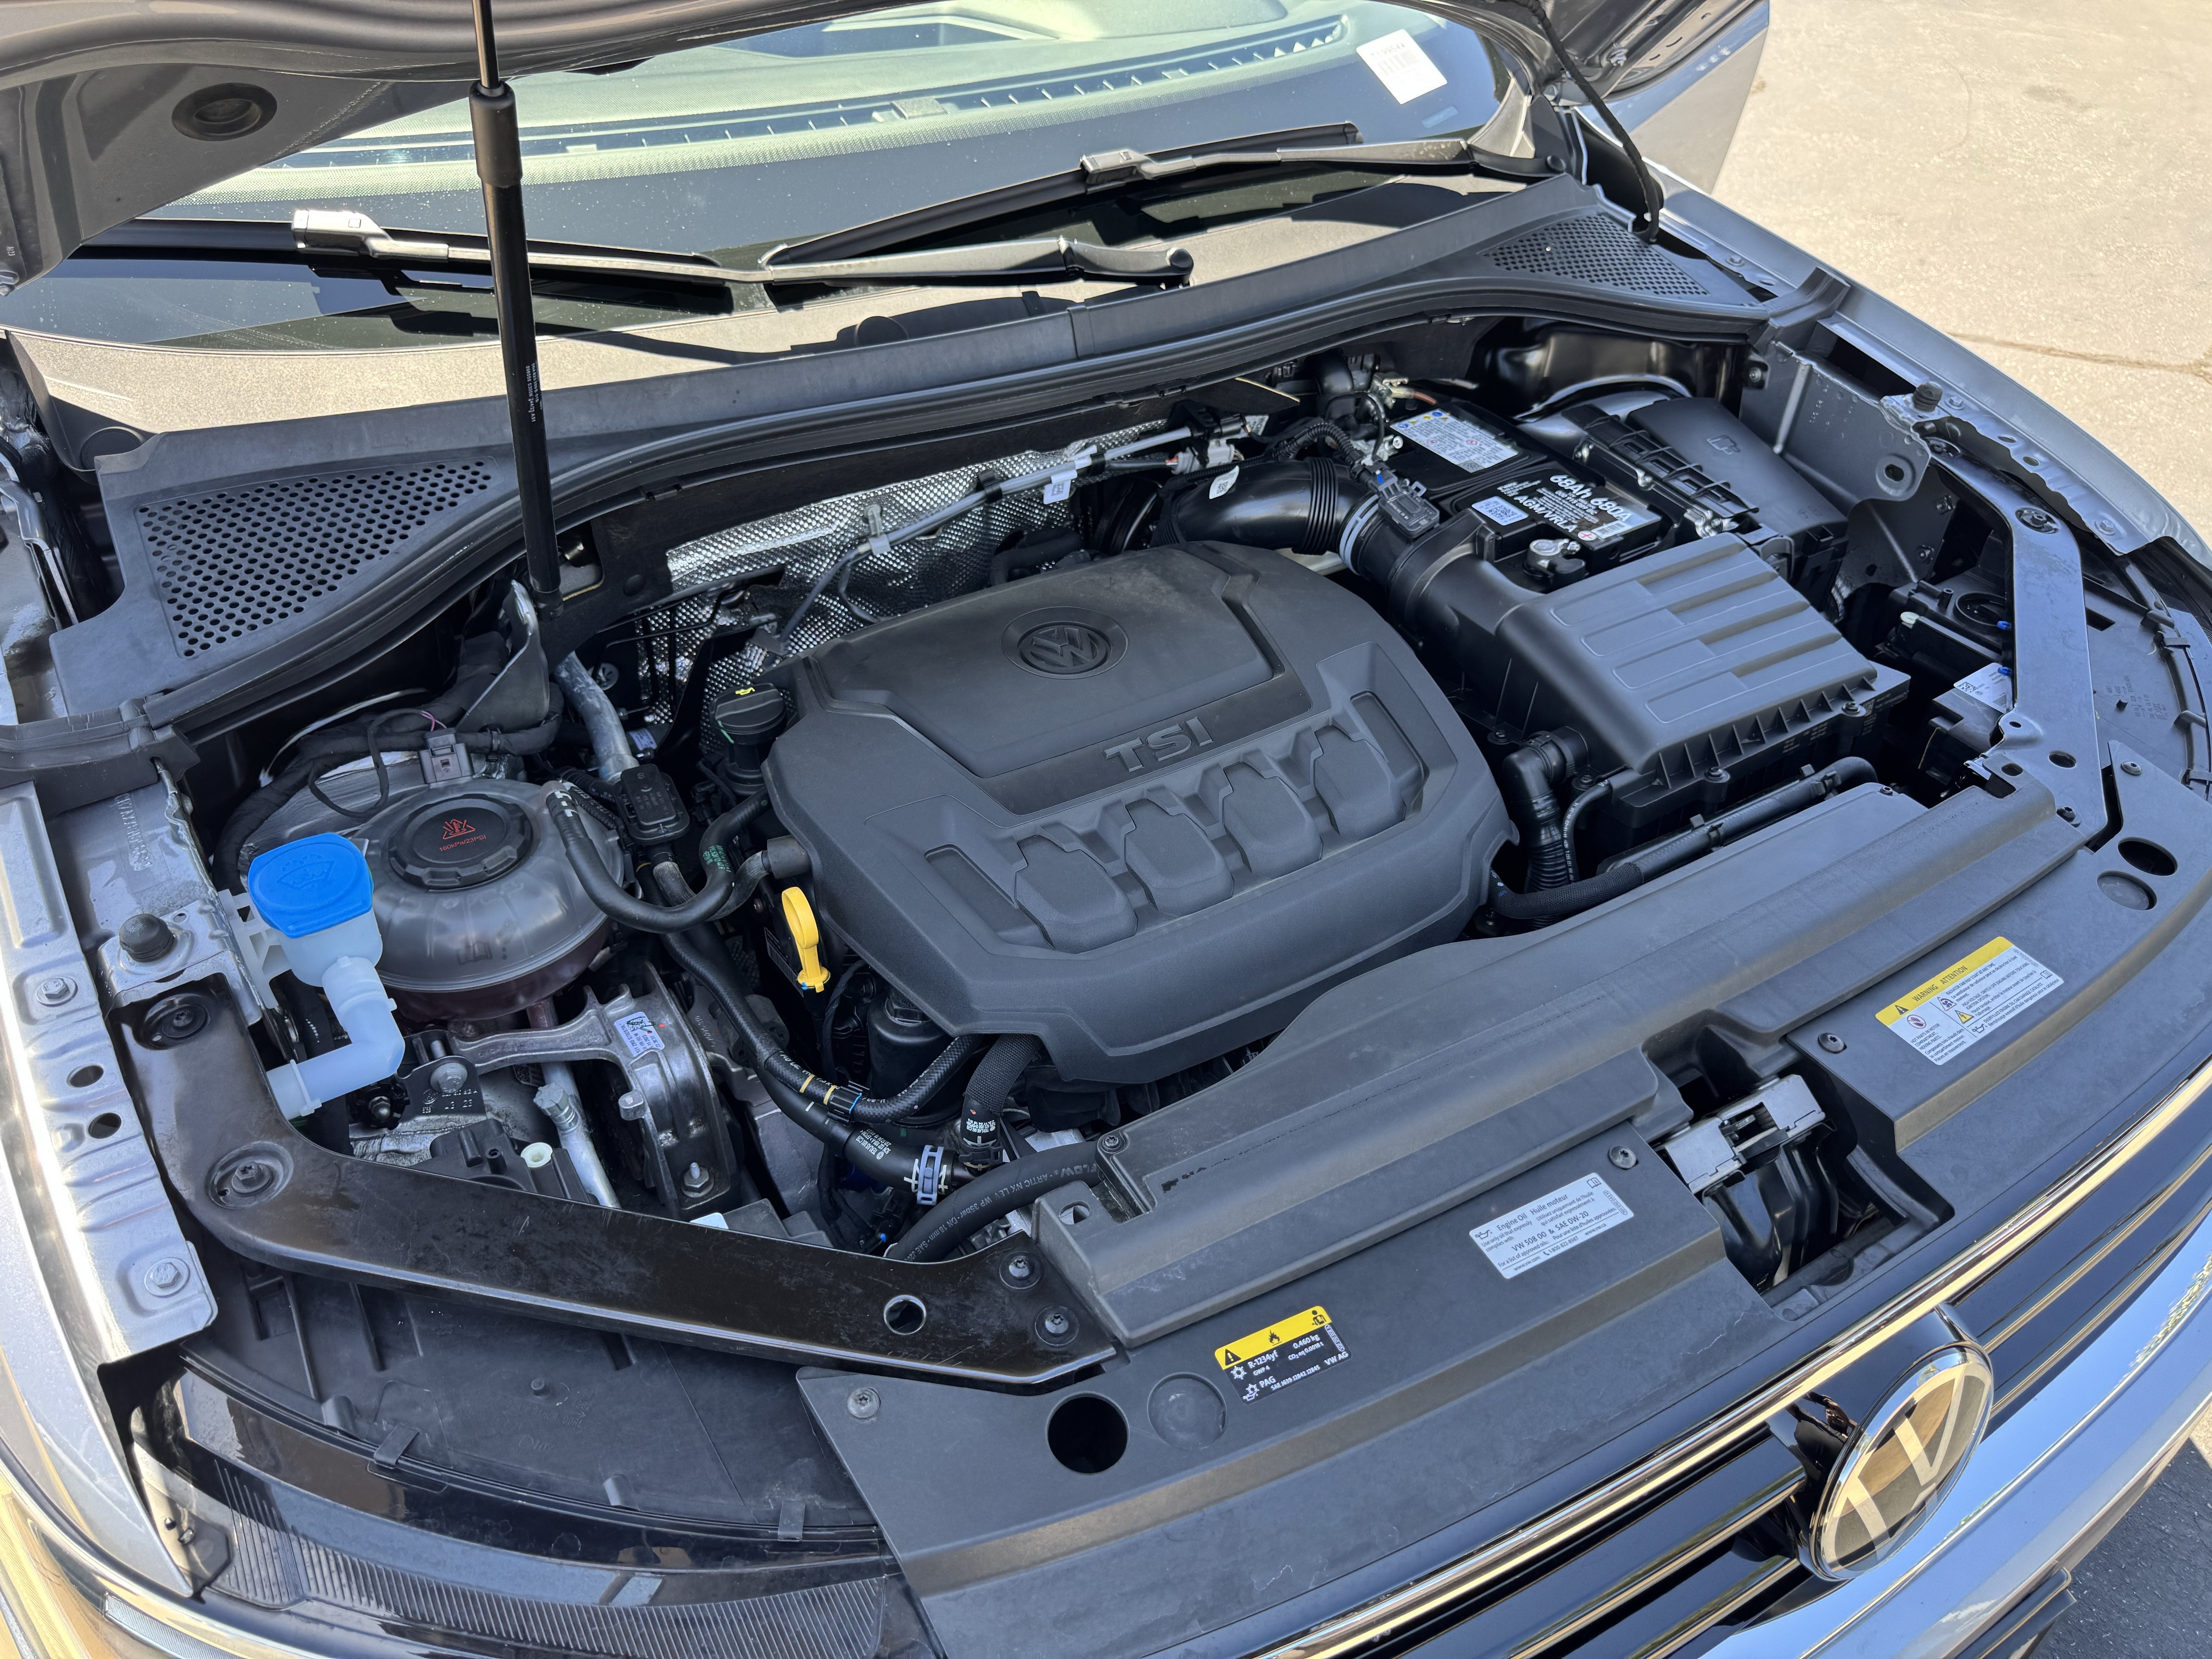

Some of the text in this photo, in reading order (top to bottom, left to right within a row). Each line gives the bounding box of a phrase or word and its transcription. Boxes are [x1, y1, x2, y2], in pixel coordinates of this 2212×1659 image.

[1550, 475, 1592, 498] 68Ah
[1590, 498, 1633, 522] 680A
[1514, 496, 1578, 532] AGM/VRLA
[1103, 717, 1213, 773] TSI
[2014, 962, 2029, 971] TOUCHING
[1912, 966, 1967, 1001] WARNING ATTENTION
[1946, 985, 1960, 994] RADIATOR
[1925, 1042, 1942, 1054] Composants
[1933, 1042, 1953, 1056] compartiment
[1953, 1035, 1965, 1043] moteur.
[1948, 1041, 1966, 1053] mouvement.
[1024, 1173, 1047, 1186] ARTIC
[994, 1187, 1010, 1199] LEV
[1010, 1182, 1023, 1192] NX
[980, 1196, 992, 1206] WP
[1530, 1195, 1567, 1214] Huile moteur
[960, 1203, 979, 1217] 35bar
[1536, 1212, 1551, 1221] Utilisez
[1552, 1200, 1576, 1213] uniquement
[1547, 1212, 1564, 1222] satisfait
[1564, 1199, 1591, 1214] expressément
[946, 1216, 958, 1226] DN
[1579, 1218, 1594, 1227] d'huiles
[1594, 1207, 1616, 1220] approuvées:
[938, 1223, 948, 1234] 18
[1497, 1219, 1518, 1230] Engine
[1511, 1242, 1524, 1250] VW
[1524, 1236, 1537, 1245] 508
[1555, 1221, 1568, 1230] SAE
[1568, 1211, 1588, 1224] 0W-20
[1513, 1221, 1532, 1231] expressly
[1585, 1223, 1606, 1235] www.vw.ca
[928, 1227, 941, 1241] mm
[914, 1239, 929, 1255] SAE
[1486, 1241, 1504, 1251] complies
[1521, 1244, 1540, 1256] approved
[1548, 1236, 1578, 1252] 1-800-822-8987
[1514, 1256, 1540, 1270] www.vw.com
[1293, 1337, 1310, 1348] 0.460
[1304, 1343, 1320, 1353] 0.0018
[1248, 1350, 1278, 1368] R-1234yf
[1324, 1351, 1348, 1365] VW AG
[1253, 1367, 1264, 1375] GWP
[1259, 1376, 1276, 1387] PAG
